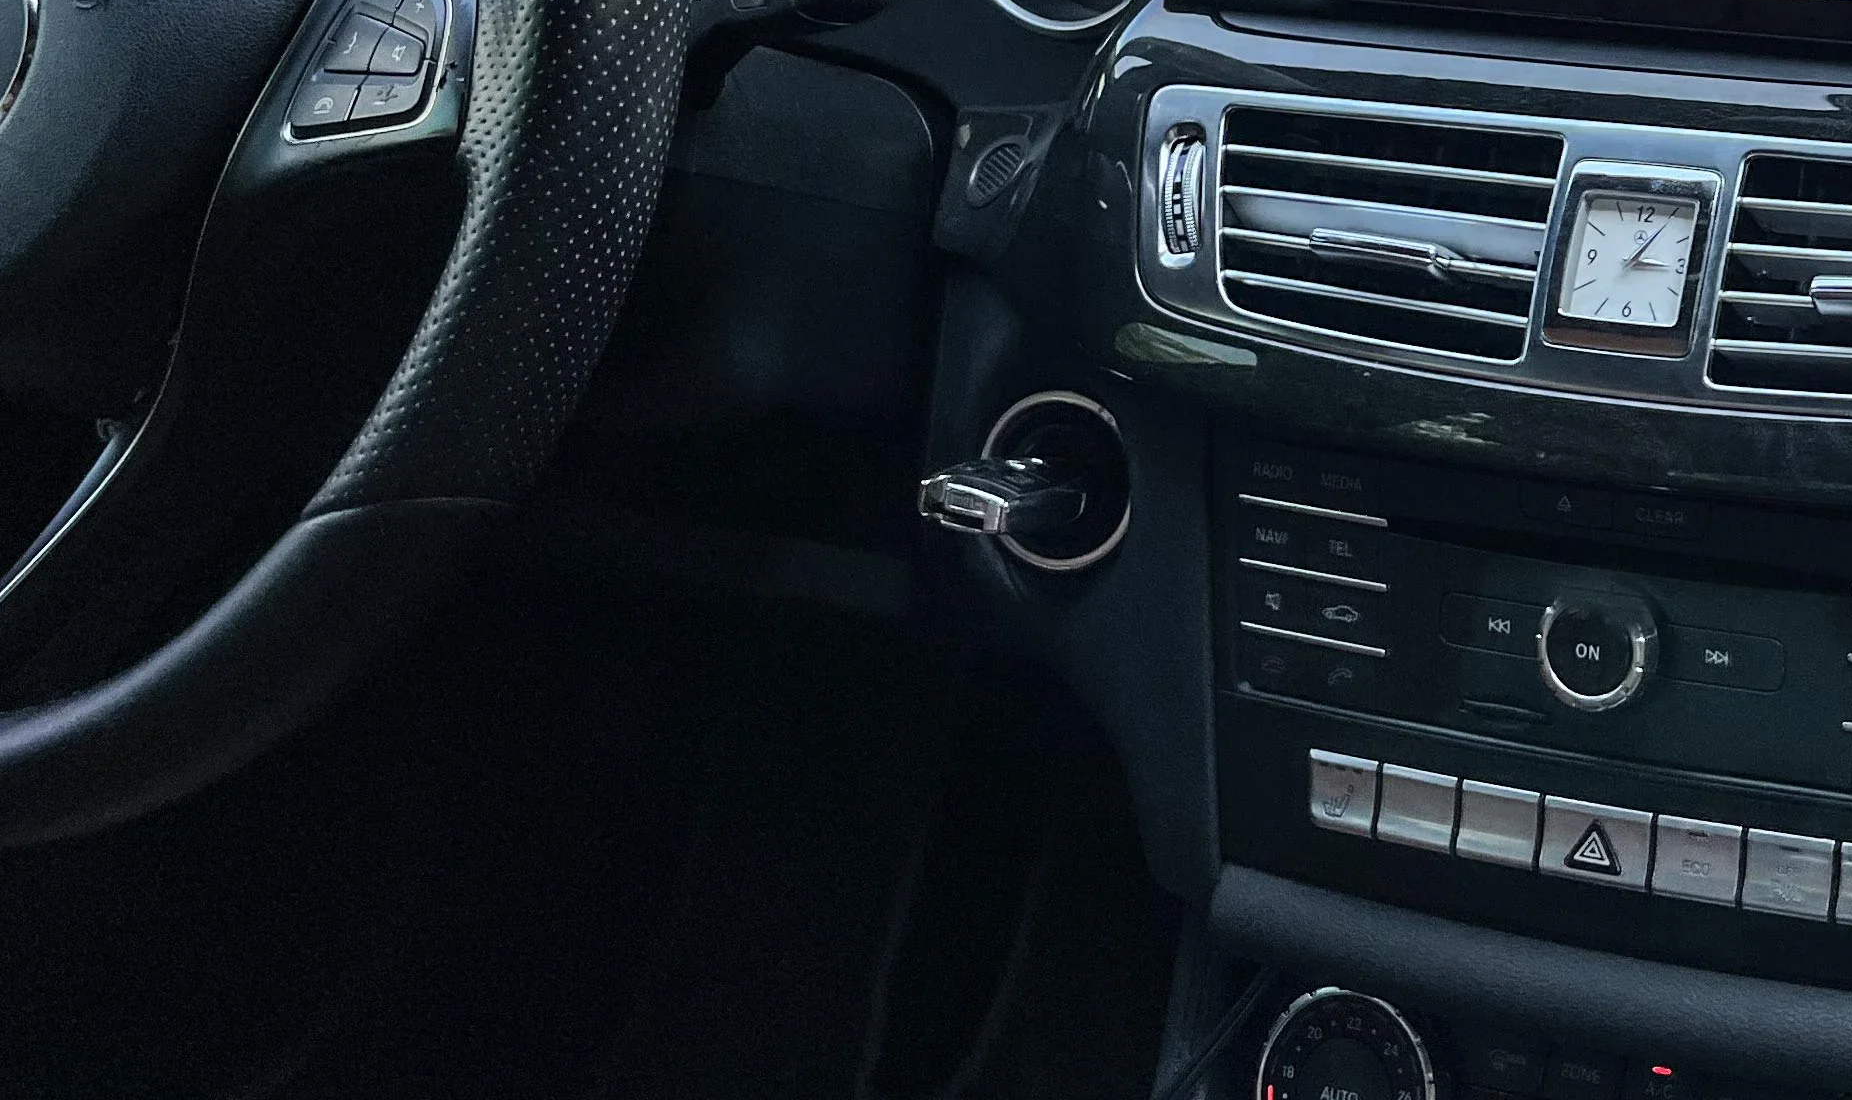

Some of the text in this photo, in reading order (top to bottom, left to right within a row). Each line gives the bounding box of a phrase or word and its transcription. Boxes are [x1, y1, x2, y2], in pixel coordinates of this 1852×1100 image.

[1637, 205, 1656, 223] 12
[1587, 248, 1598, 266] 9
[1675, 258, 1686, 275] 3
[1621, 300, 1632, 318] 6
[1252, 460, 1293, 482] RADIO
[1255, 526, 1289, 546] NAVI
[1328, 538, 1353, 558] TEL
[1575, 642, 1601, 661] ON
[1307, 1025, 1323, 1040] 20
[1383, 1041, 1399, 1057] 24
[1282, 1064, 1295, 1080] 18
[1320, 1085, 1359, 1100] AUTO
